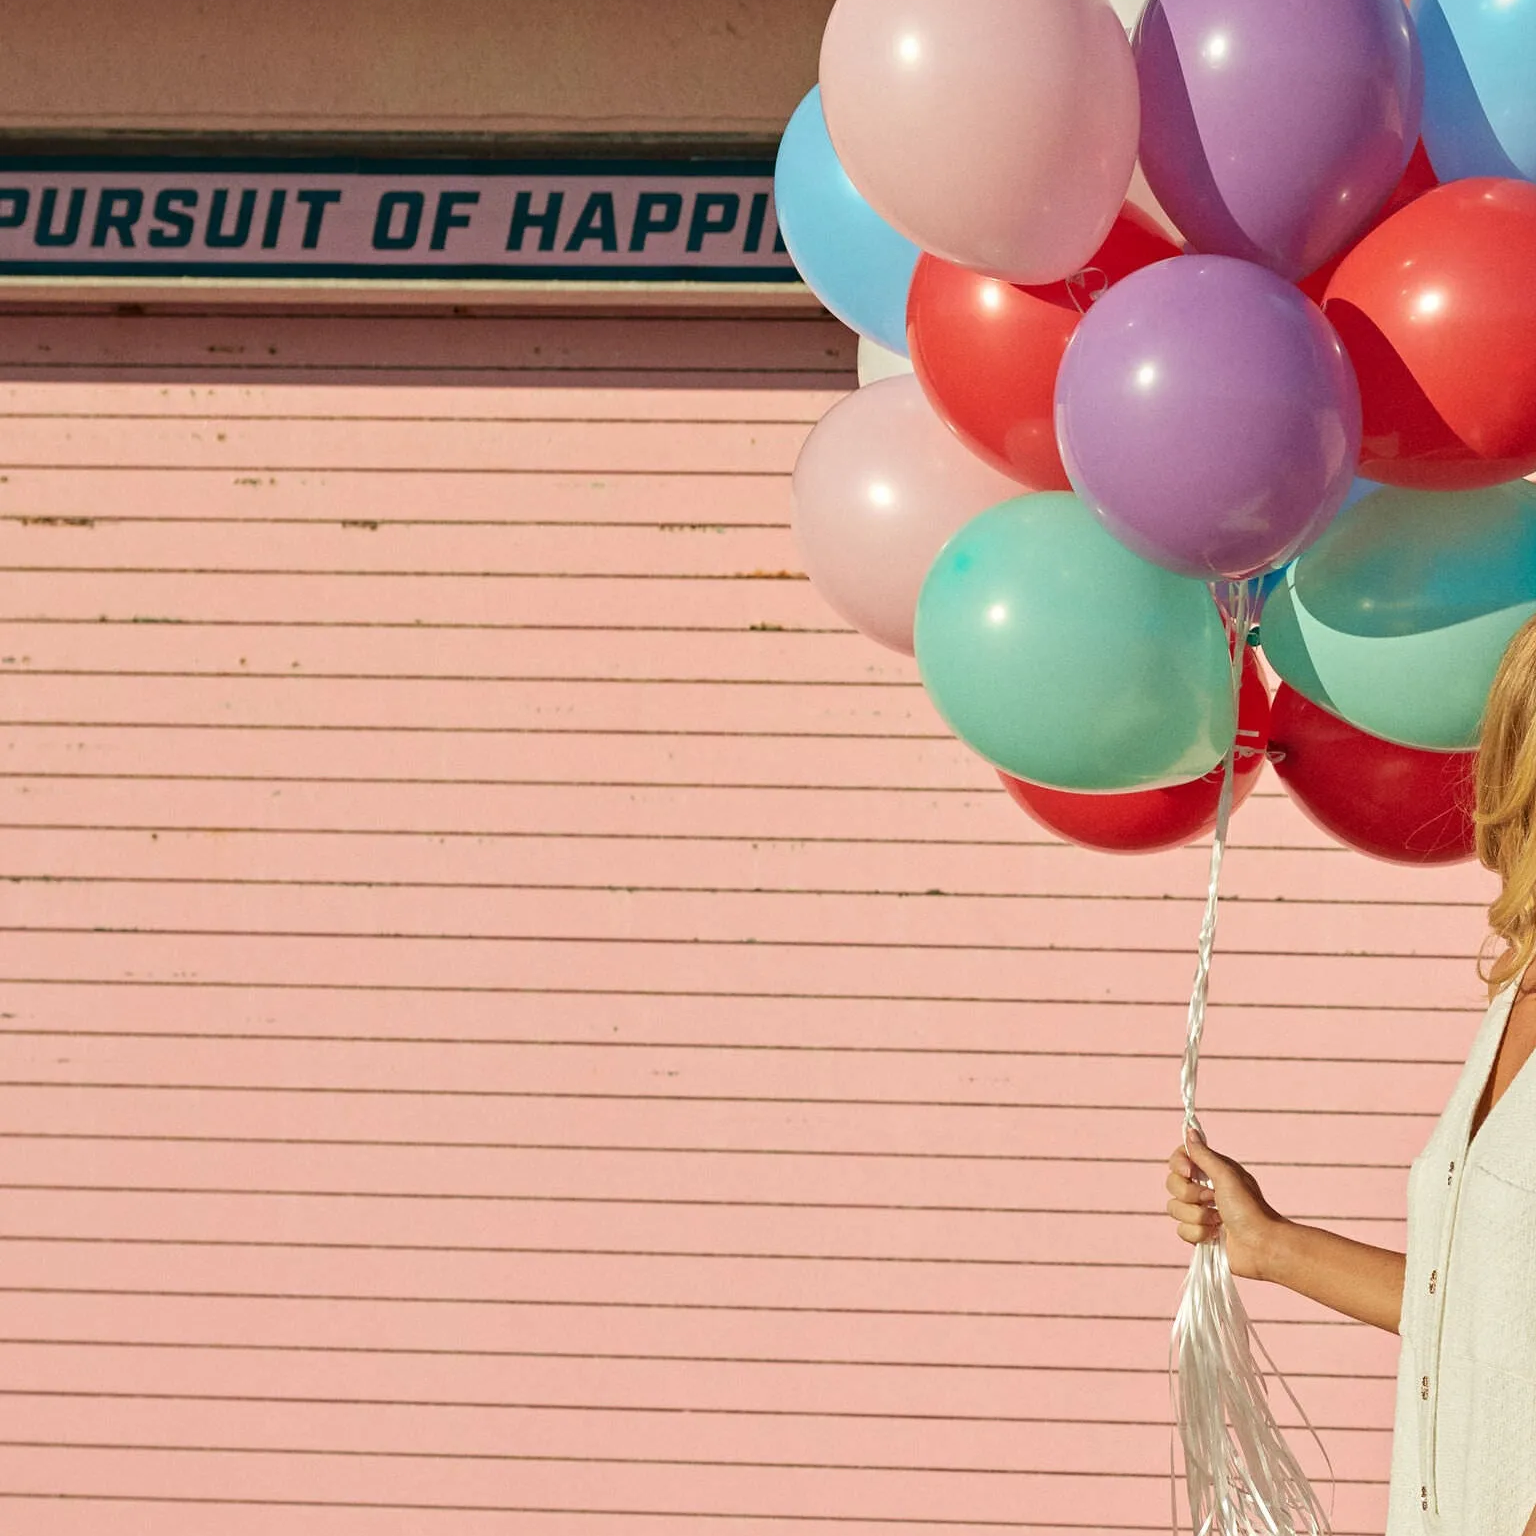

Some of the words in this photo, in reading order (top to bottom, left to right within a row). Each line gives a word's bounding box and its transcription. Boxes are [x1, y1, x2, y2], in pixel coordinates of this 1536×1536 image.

[0, 187, 342, 250] PURSUIT
[371, 190, 482, 251] OF
[505, 191, 788, 253] HAPPI
